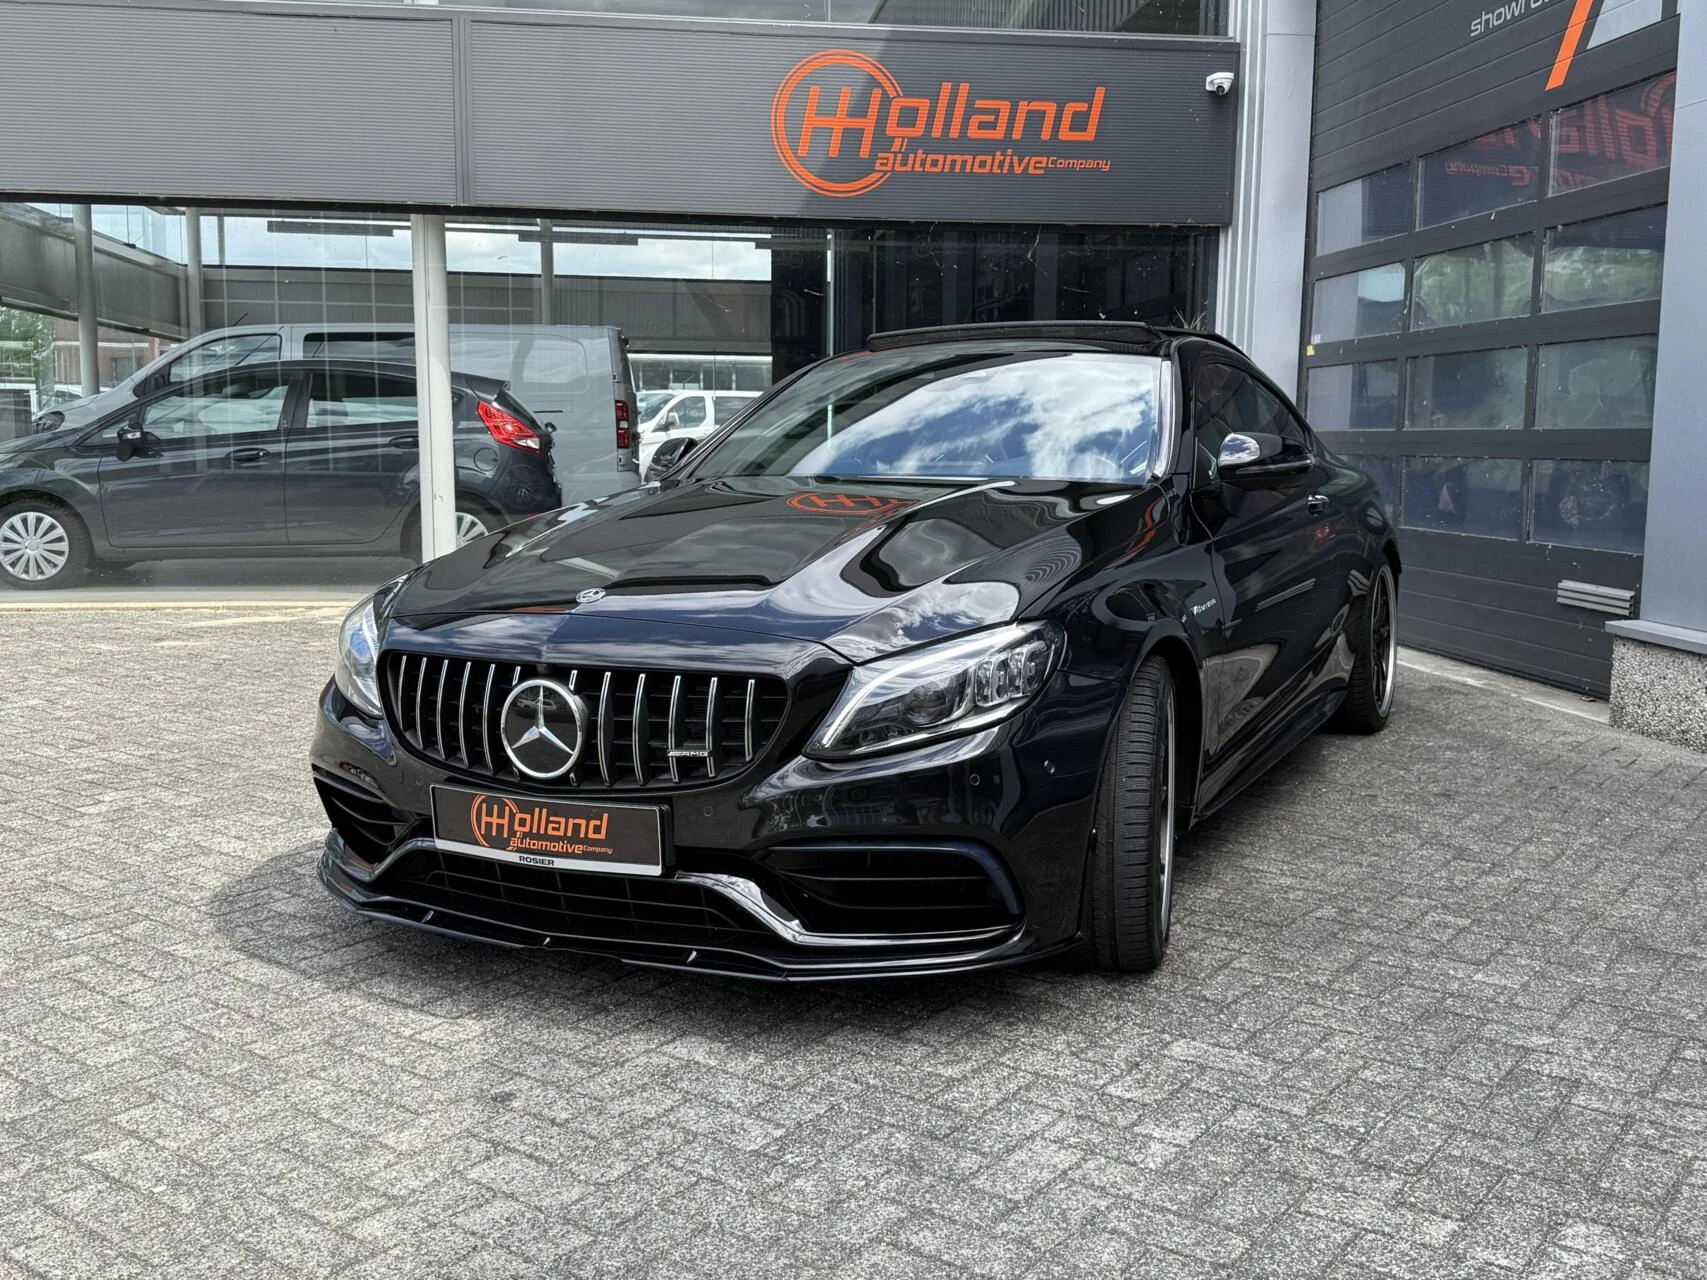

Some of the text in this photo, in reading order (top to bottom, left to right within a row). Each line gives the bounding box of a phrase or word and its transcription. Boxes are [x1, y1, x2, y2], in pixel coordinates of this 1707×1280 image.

[874, 148, 1111, 176] automotive Company
[510, 836, 613, 854] automotive Company
[518, 855, 555, 867] ROSIER
